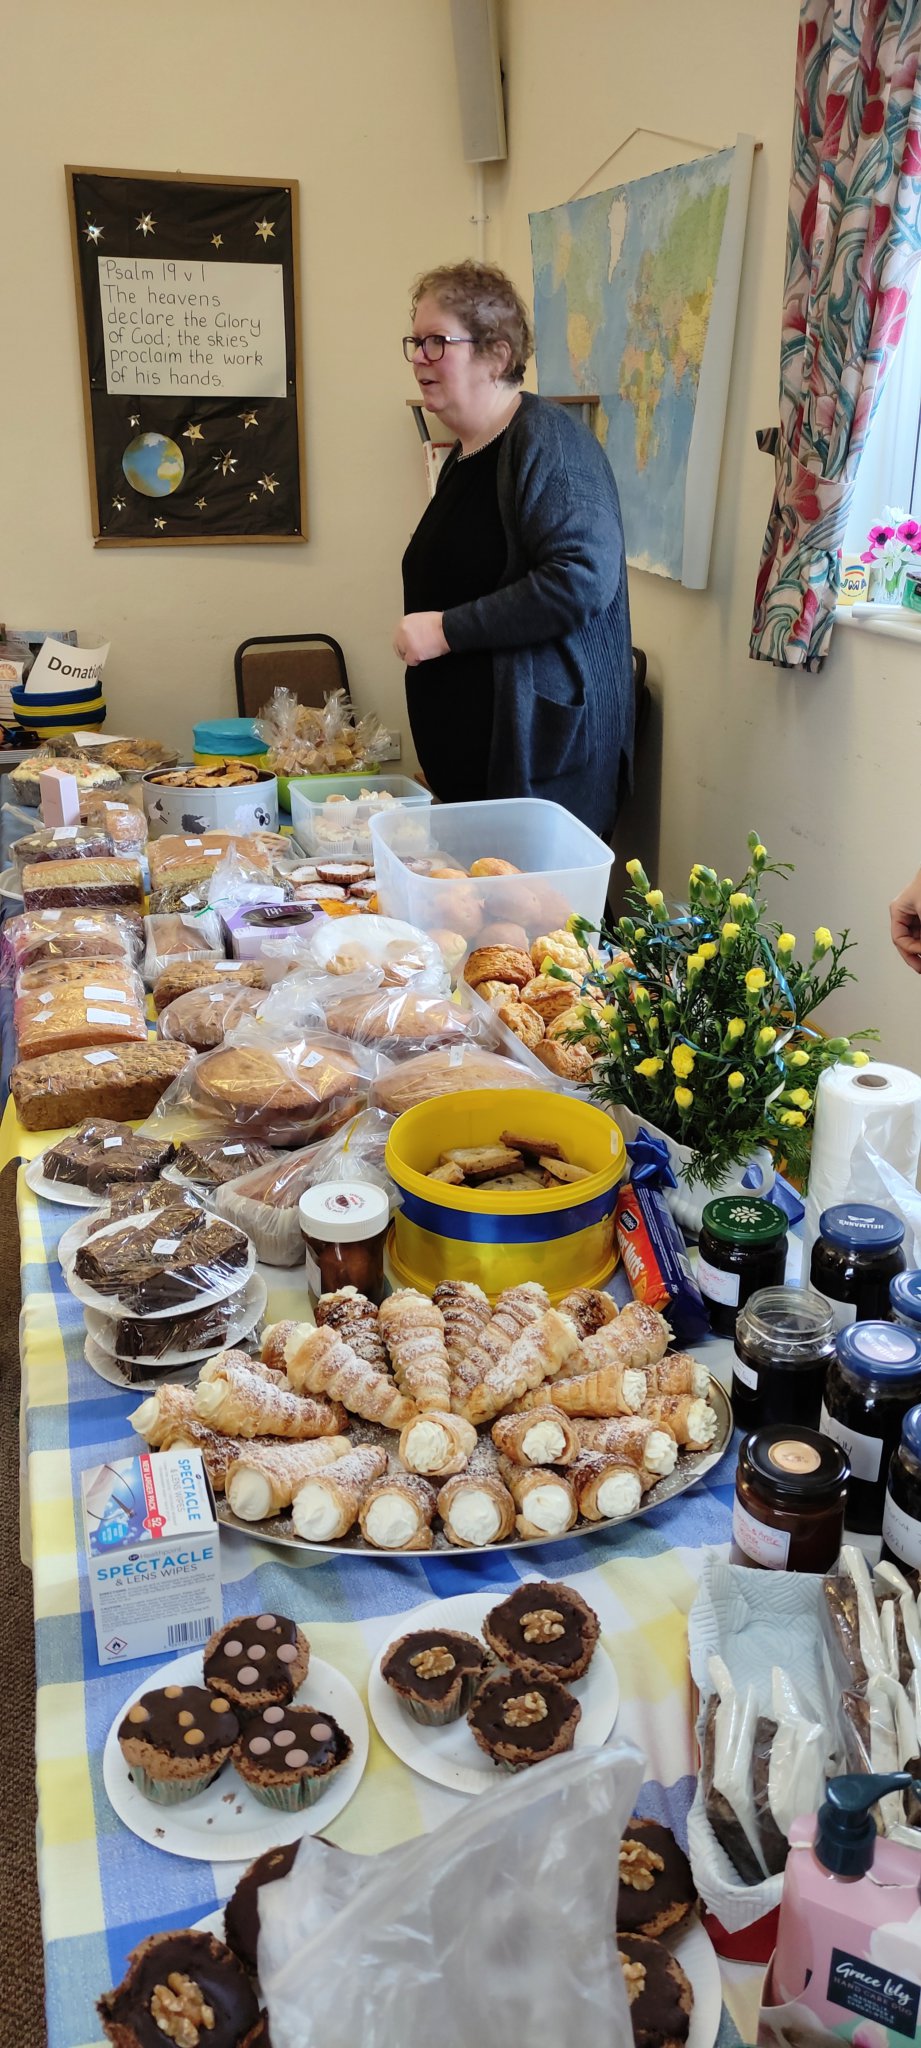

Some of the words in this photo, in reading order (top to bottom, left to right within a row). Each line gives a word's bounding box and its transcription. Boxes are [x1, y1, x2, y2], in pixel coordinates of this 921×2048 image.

[106, 259, 154, 281] Psalm
[162, 262, 176, 282] 19
[183, 271, 192, 282] v
[103, 284, 136, 303] The
[147, 286, 221, 308] heavens
[107, 306, 174, 327] declare
[184, 310, 208, 328] the
[214, 312, 261, 337] Glory
[108, 327, 125, 344] of
[131, 327, 171, 347] God;
[178, 329, 200, 346] the
[208, 330, 248, 348] skies
[110, 349, 182, 369] proclaim
[189, 349, 214, 365] the
[223, 351, 263, 366] work
[111, 365, 128, 383] of
[135, 366, 161, 385] his
[169, 367, 225, 388] hands.
[142, 1461, 150, 1473] NEW
[144, 1473, 155, 1496] LARGER
[171, 1474, 180, 1492] LENS
[178, 1459, 201, 1521] SPECTACLE
[147, 1496, 157, 1512] PACK
[175, 1493, 185, 1513] WIPES
[151, 1517, 162, 1527] 52
[97, 1547, 214, 1581] SPECTACLE
[115, 1579, 123, 1587] &
[127, 1572, 157, 1585] LENS
[160, 1563, 198, 1578] WIPES
[835, 1962, 881, 1988] Grace
[883, 1978, 914, 2006] Lily
[834, 1976, 861, 1993] HAND
[863, 1990, 889, 2005] CARE
[891, 2002, 913, 2017] DUO
